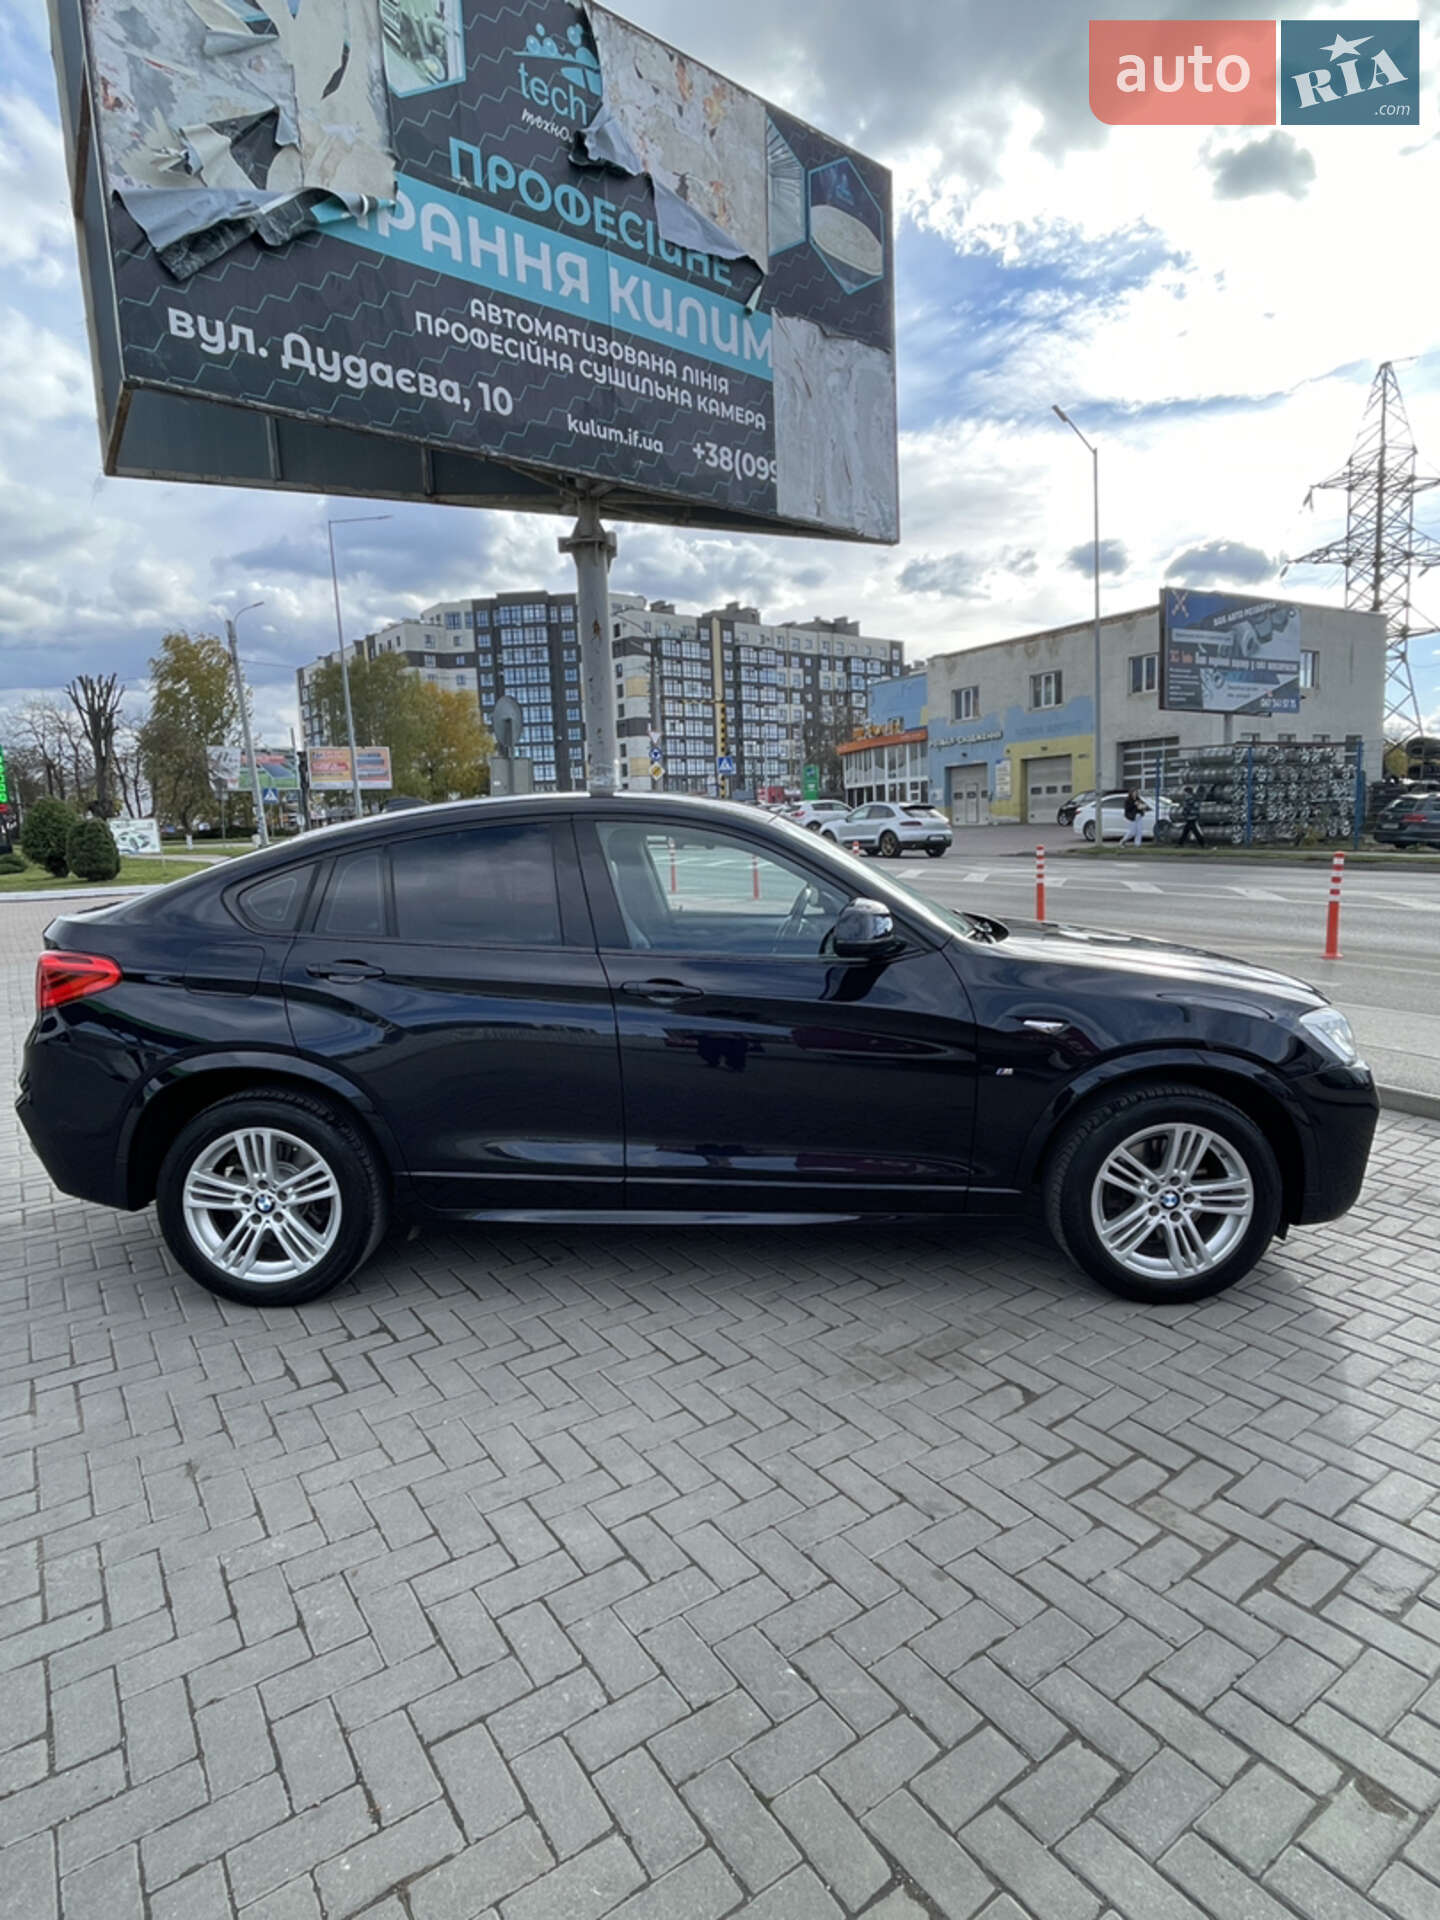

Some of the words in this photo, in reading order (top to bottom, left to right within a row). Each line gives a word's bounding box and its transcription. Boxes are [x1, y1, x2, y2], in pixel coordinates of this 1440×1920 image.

[167, 307, 268, 358] вул.
[281, 333, 471, 412] Дудаєва,
[478, 382, 513, 416] 10
[415, 311, 574, 374] ПРОФЕСІЙНА
[579, 357, 693, 409] СУШИЛЬНА
[697, 393, 766, 431] КАМЕРА
[470, 298, 677, 383] АВТОМАТИЗОВАНА
[681, 365, 729, 396] ЛІНІЯ
[567, 414, 664, 455] kulum.if.ua
